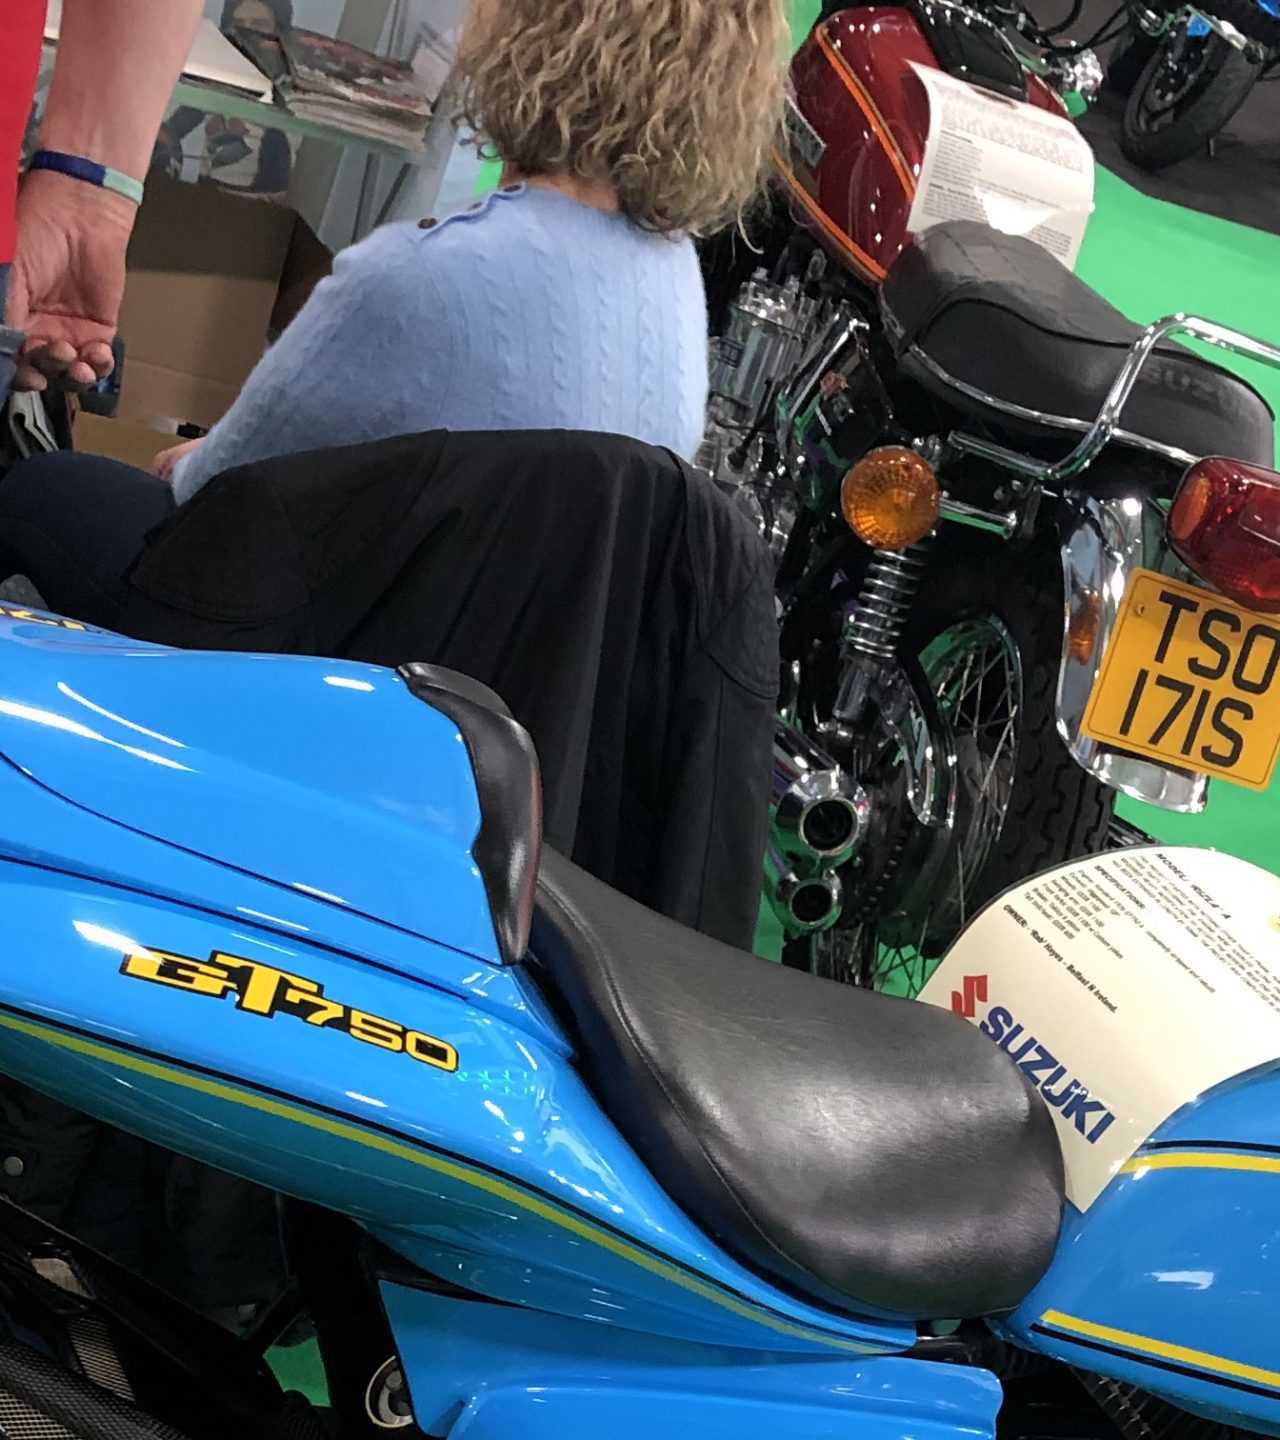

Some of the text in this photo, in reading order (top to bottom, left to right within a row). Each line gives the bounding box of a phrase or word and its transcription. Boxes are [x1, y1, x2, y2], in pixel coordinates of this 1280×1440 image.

[1119, 669, 1255, 769] 171S
[119, 946, 462, 1074] GT750
[1003, 905, 1027, 928] OWNER:
[1044, 943, 1063, 962] Hayes
[1066, 964, 1090, 986] Belfast
[1093, 990, 1117, 1013] Ireland.
[978, 1005, 1117, 1145] SUZUKI
